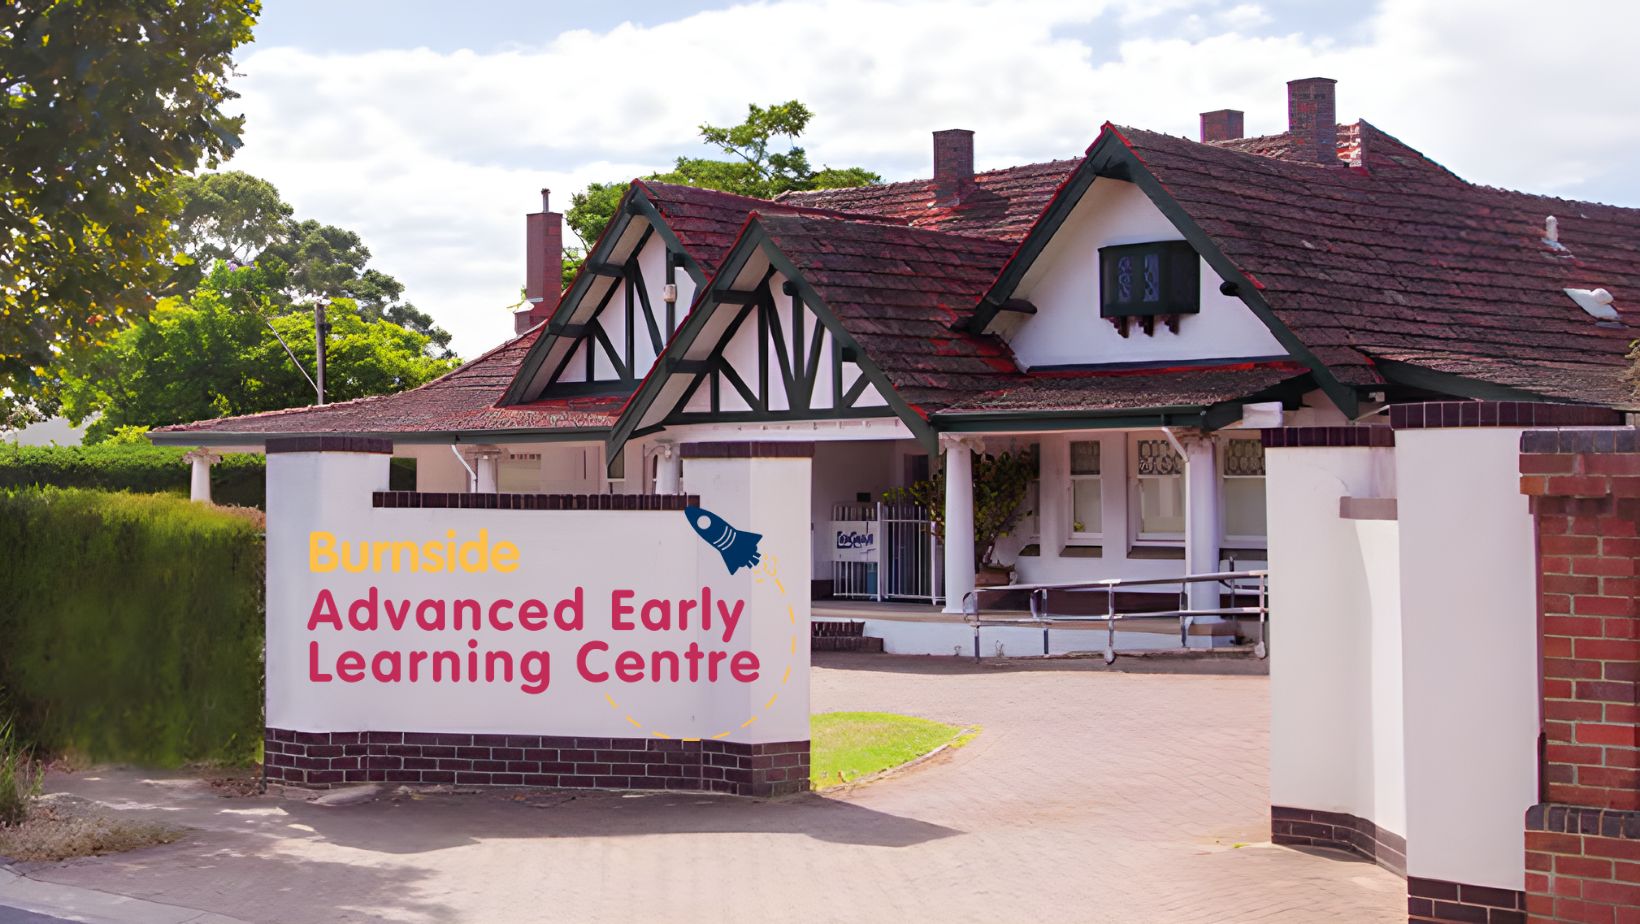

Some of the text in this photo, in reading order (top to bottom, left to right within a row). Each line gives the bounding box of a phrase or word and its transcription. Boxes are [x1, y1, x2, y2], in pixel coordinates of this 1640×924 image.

[309, 527, 521, 574] Burnside
[307, 586, 745, 643] Advanced Early
[309, 638, 760, 695] Learning Centre
